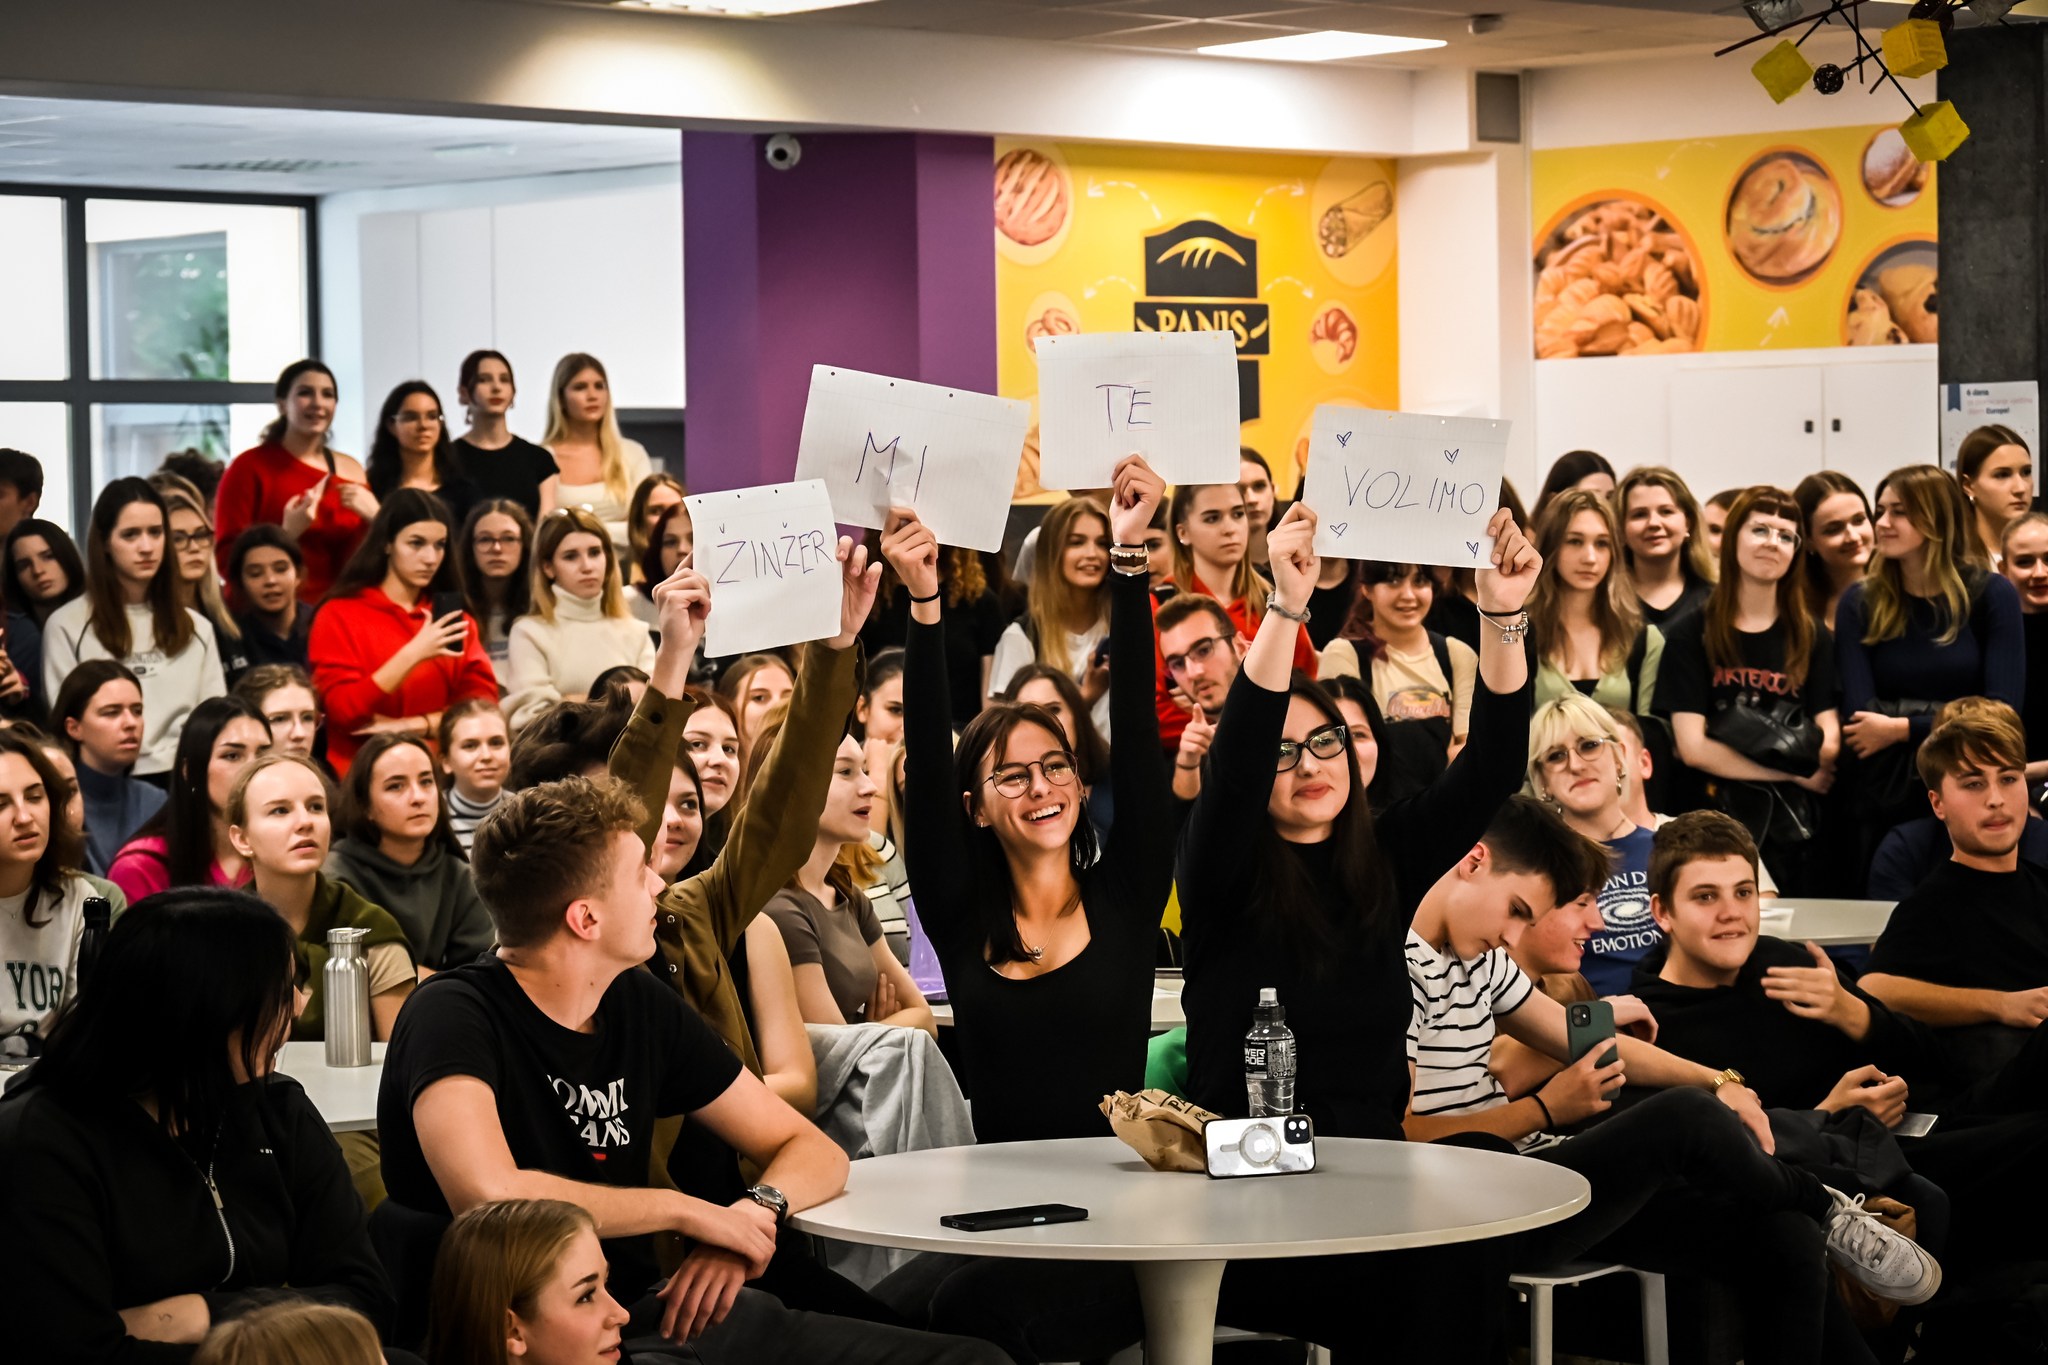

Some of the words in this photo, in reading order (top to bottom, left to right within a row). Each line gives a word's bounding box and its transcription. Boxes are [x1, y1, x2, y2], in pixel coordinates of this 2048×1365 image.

[1095, 382, 1153, 435] TE
[855, 431, 928, 503] MI
[1344, 465, 1485, 515] VOLIMO
[716, 521, 833, 584] ŽINŽER
